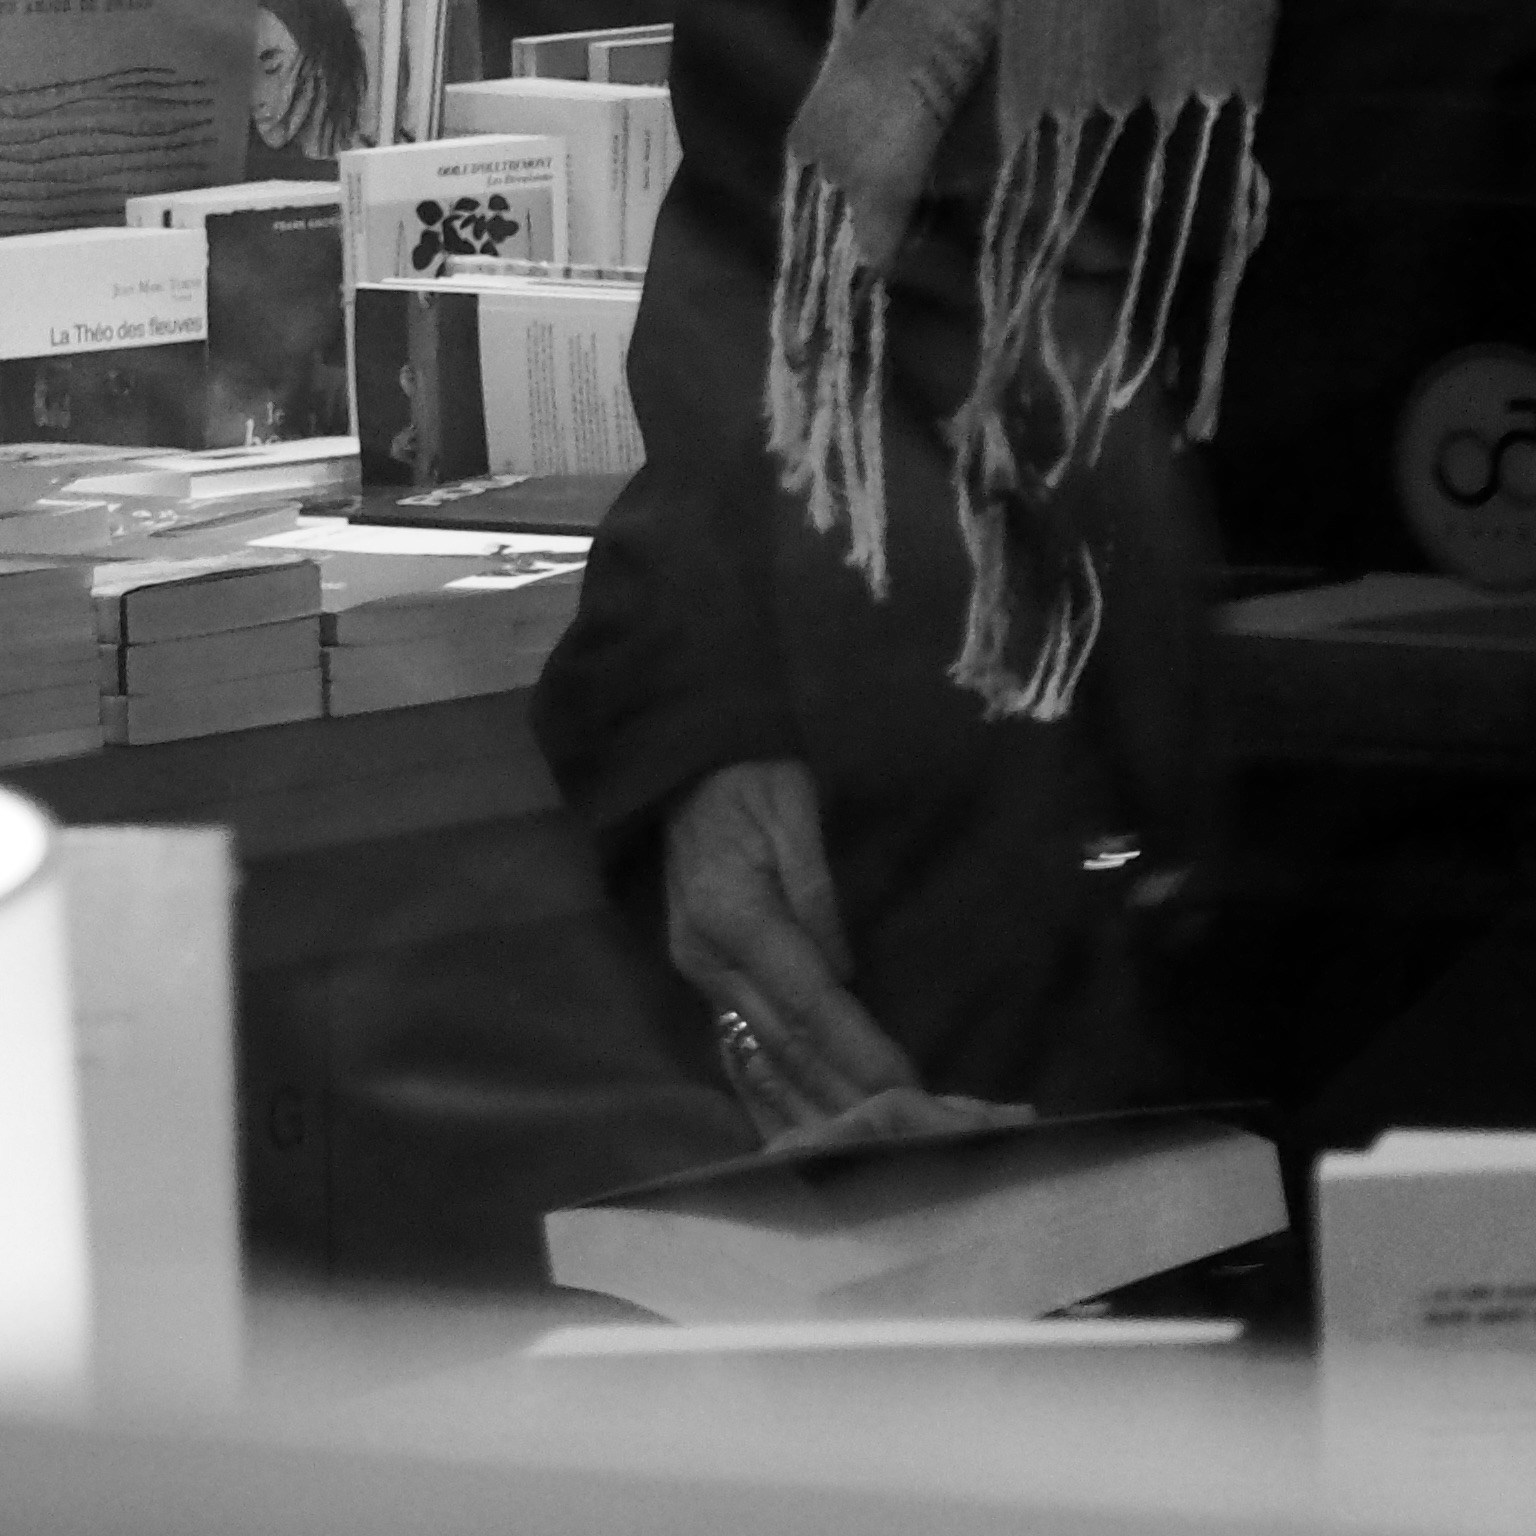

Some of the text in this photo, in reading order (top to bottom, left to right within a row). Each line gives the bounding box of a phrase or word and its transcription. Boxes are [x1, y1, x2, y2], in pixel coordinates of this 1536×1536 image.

[50, 326, 70, 348] La
[73, 321, 115, 345] Théo
[116, 320, 146, 341] des
